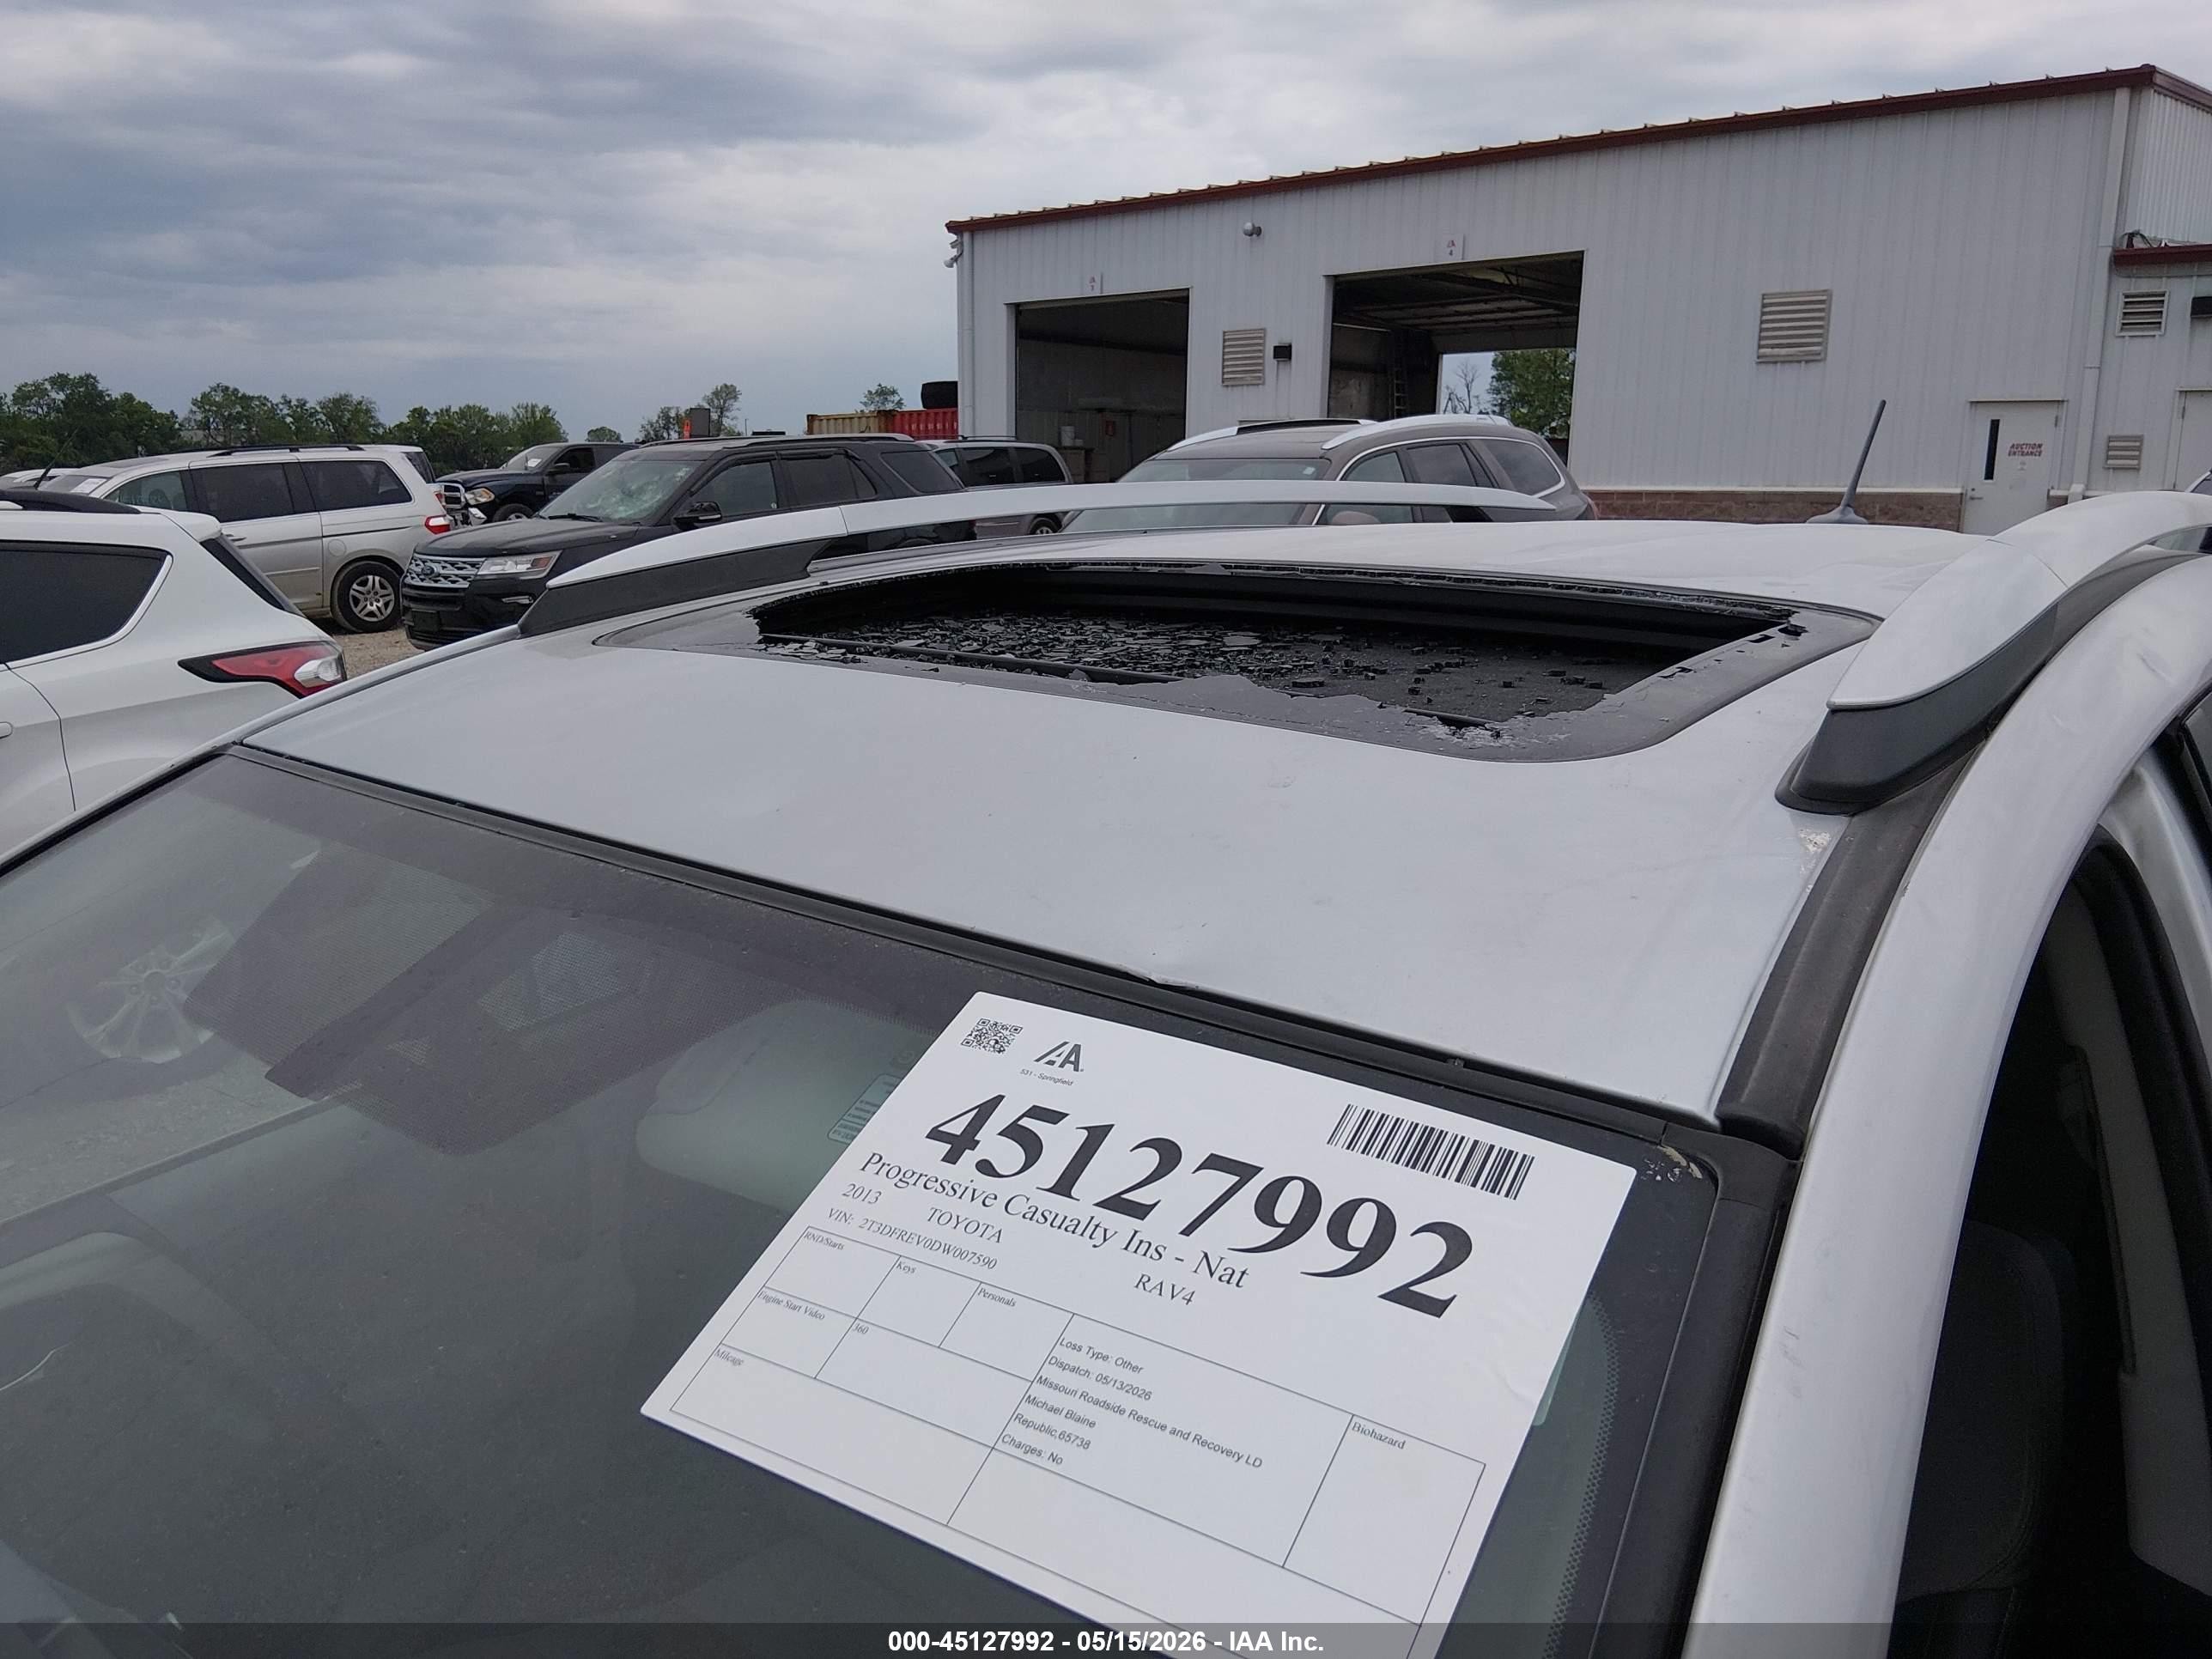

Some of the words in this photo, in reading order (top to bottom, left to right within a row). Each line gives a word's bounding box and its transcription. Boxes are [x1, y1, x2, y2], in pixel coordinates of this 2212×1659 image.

[1019, 1068, 1033, 1077] 531
[1037, 1072, 1074, 1086] Springfield
[859, 1152, 999, 1208] Progressive
[1003, 1194, 1119, 1250] Casualty
[1121, 1229, 1168, 1262] Ins
[1192, 1251, 1249, 1289] Nat
[925, 1094, 1473, 1318] 45127992
[803, 1231, 846, 1250] RND/Starts
[827, 1207, 854, 1225] VIN:
[858, 1218, 998, 1270] 2T3DFREV0DW007590
[842, 1183, 882, 1204] 2013
[927, 1207, 1003, 1243] TOYOTA
[1134, 1273, 1196, 1306] RAV4
[896, 1261, 916, 1275] Keys
[757, 1291, 783, 1309] Engine
[784, 1299, 802, 1314] Start
[803, 1305, 825, 1322] Video
[977, 1287, 1017, 1308] Personals
[853, 1322, 870, 1335] 360
[714, 1347, 744, 1366] Mileage
[1059, 1337, 1083, 1353] Loss
[1085, 1345, 1113, 1363] Type:
[1114, 1357, 1144, 1375] Other
[1048, 1355, 1093, 1380] Dispatch:
[1096, 1372, 1153, 1401] 05/13/2026
[1024, 1394, 1064, 1417] Michael
[1065, 1407, 1097, 1429] Blaine
[1036, 1374, 1078, 1397] Missouri
[1079, 1390, 1127, 1416] Roadside
[1128, 1409, 1168, 1431] Rescue
[1169, 1425, 1191, 1442] and
[1193, 1433, 1245, 1462] Recovery
[1245, 1454, 1263, 1468] LD
[1001, 1433, 1046, 1458] Charges:
[1048, 1451, 1063, 1465] No
[1352, 1421, 1407, 1450] Biohazard
